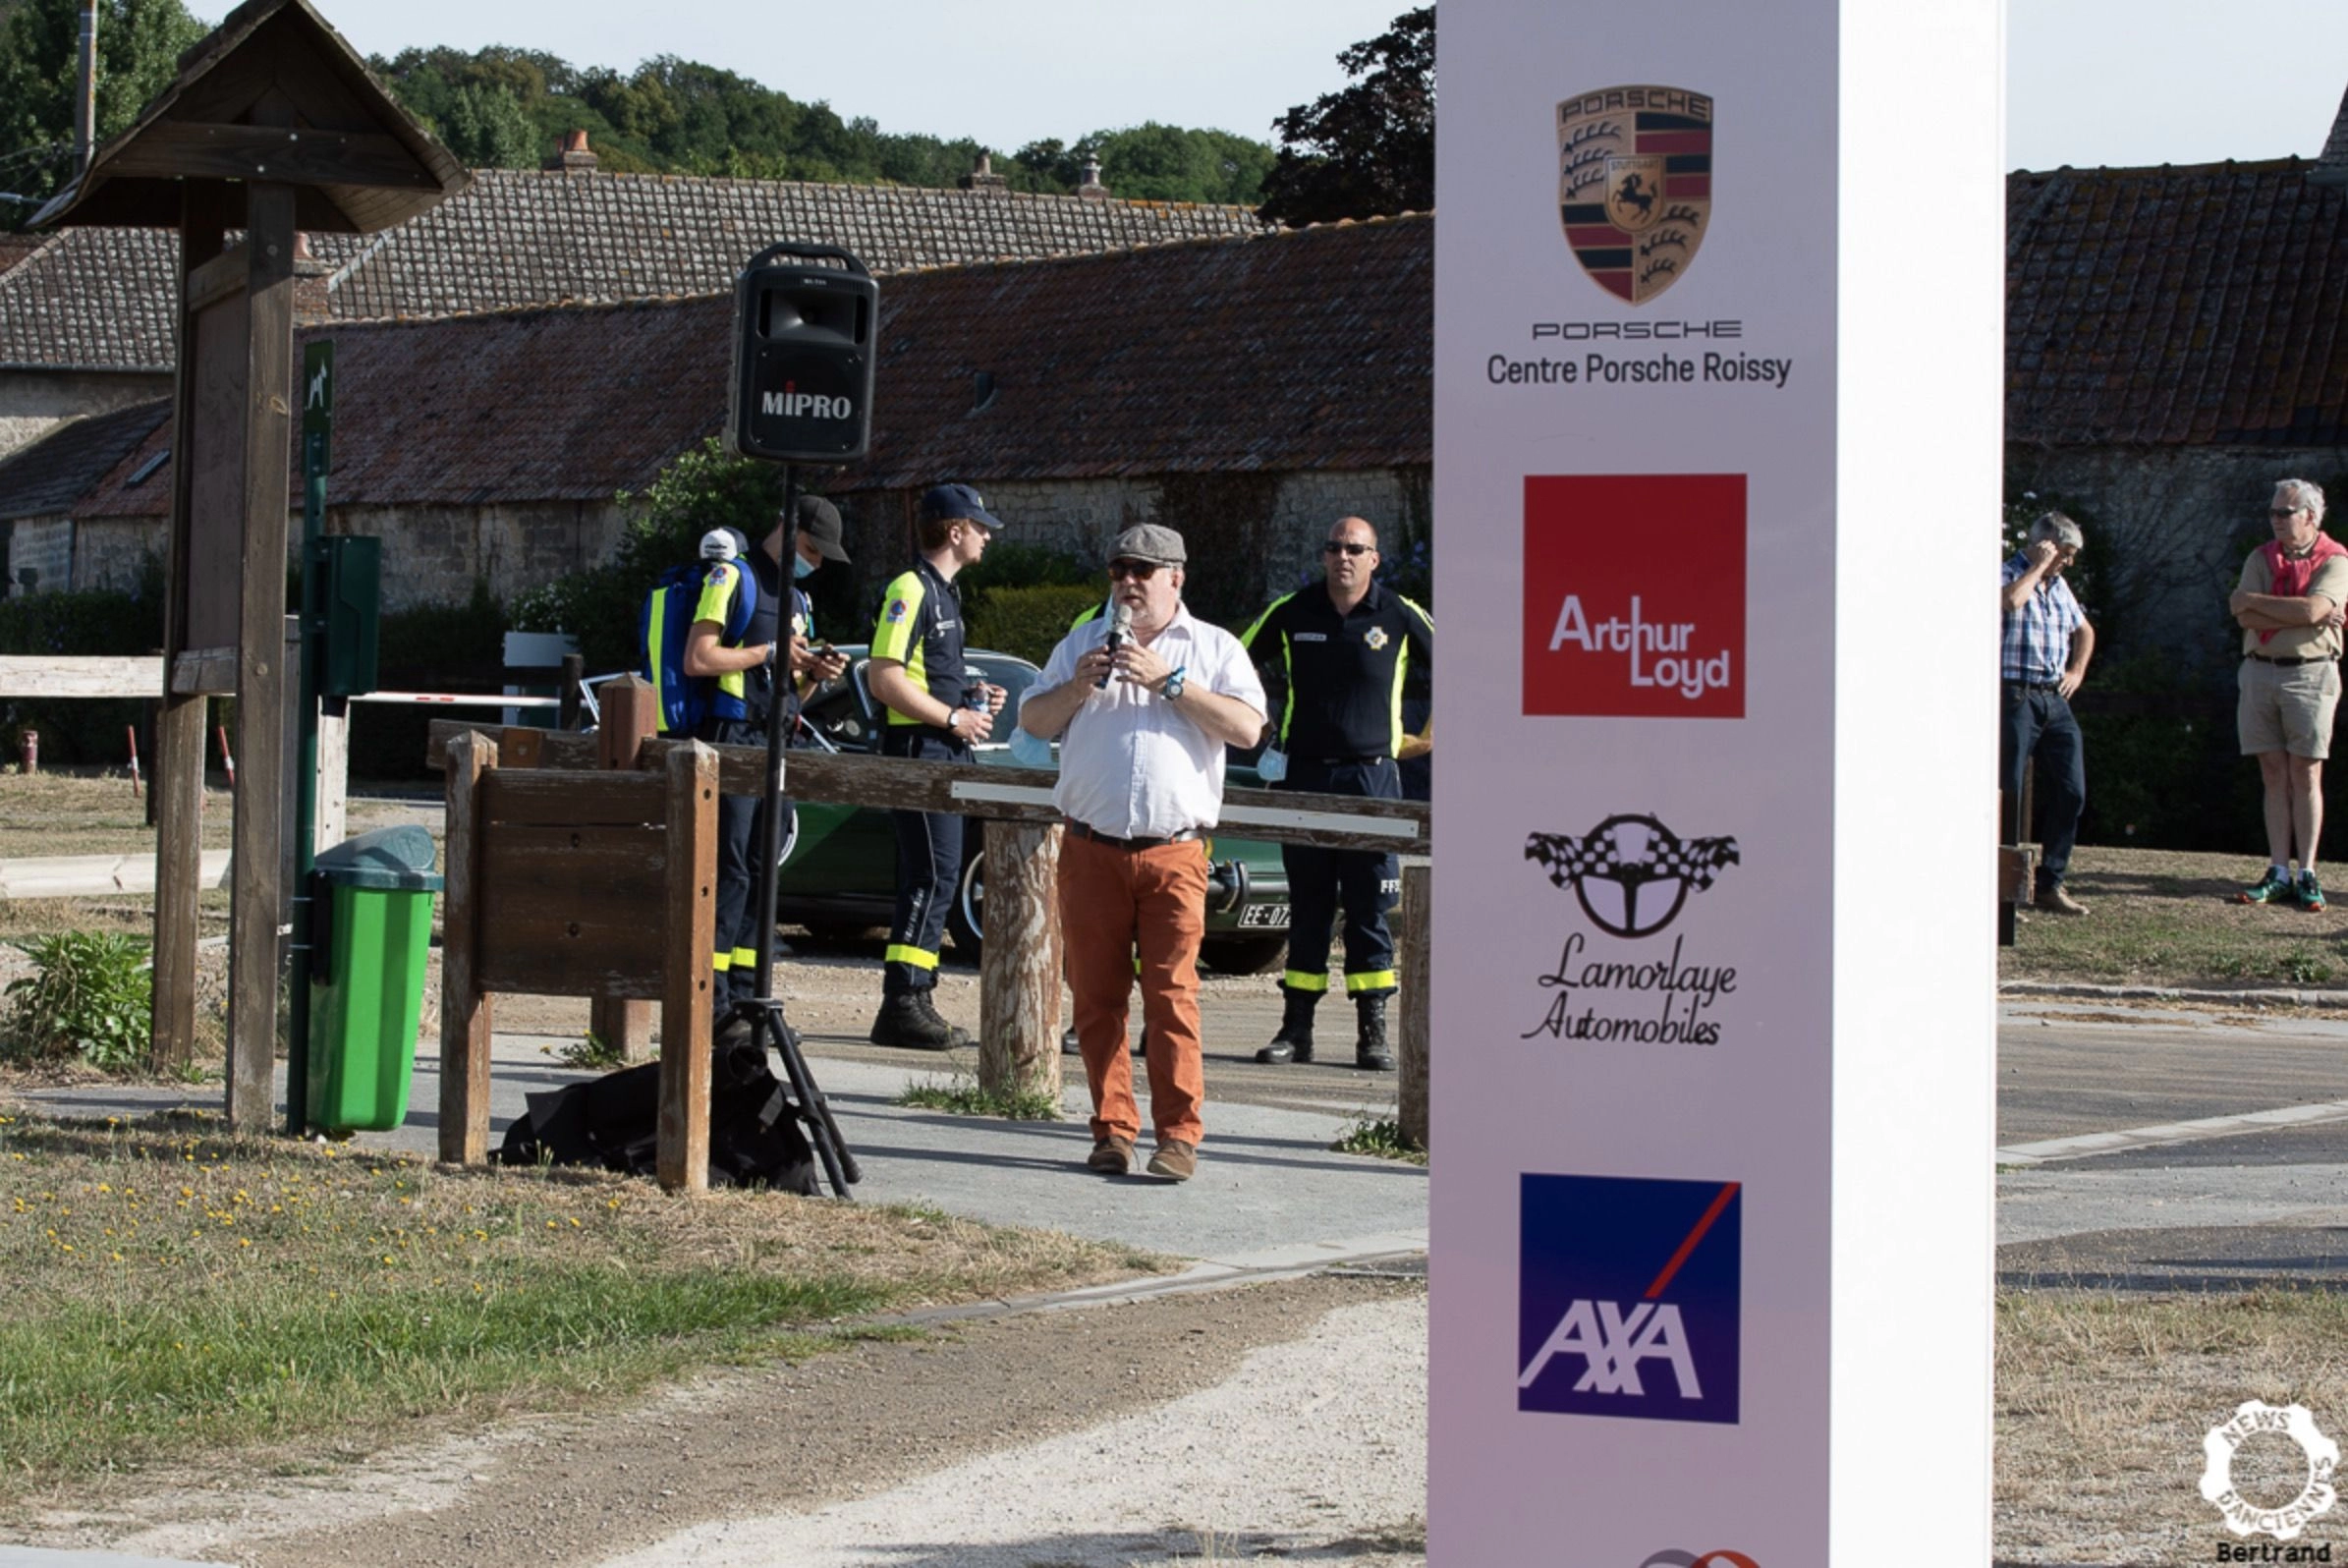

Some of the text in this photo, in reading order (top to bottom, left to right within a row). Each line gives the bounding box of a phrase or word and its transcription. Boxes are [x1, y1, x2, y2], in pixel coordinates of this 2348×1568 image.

[1561, 89, 1707, 124] PORSCHE
[1533, 320, 1742, 340] PORSCHE
[1487, 352, 1792, 388] Centre Porsche Roissy
[1548, 594, 1695, 651] Arthur
[1631, 649, 1729, 699] Loyd
[1537, 932, 1737, 1008] Lamorlaye
[1520, 990, 1720, 1045] Automobiles
[1518, 1299, 1704, 1399] AXA
